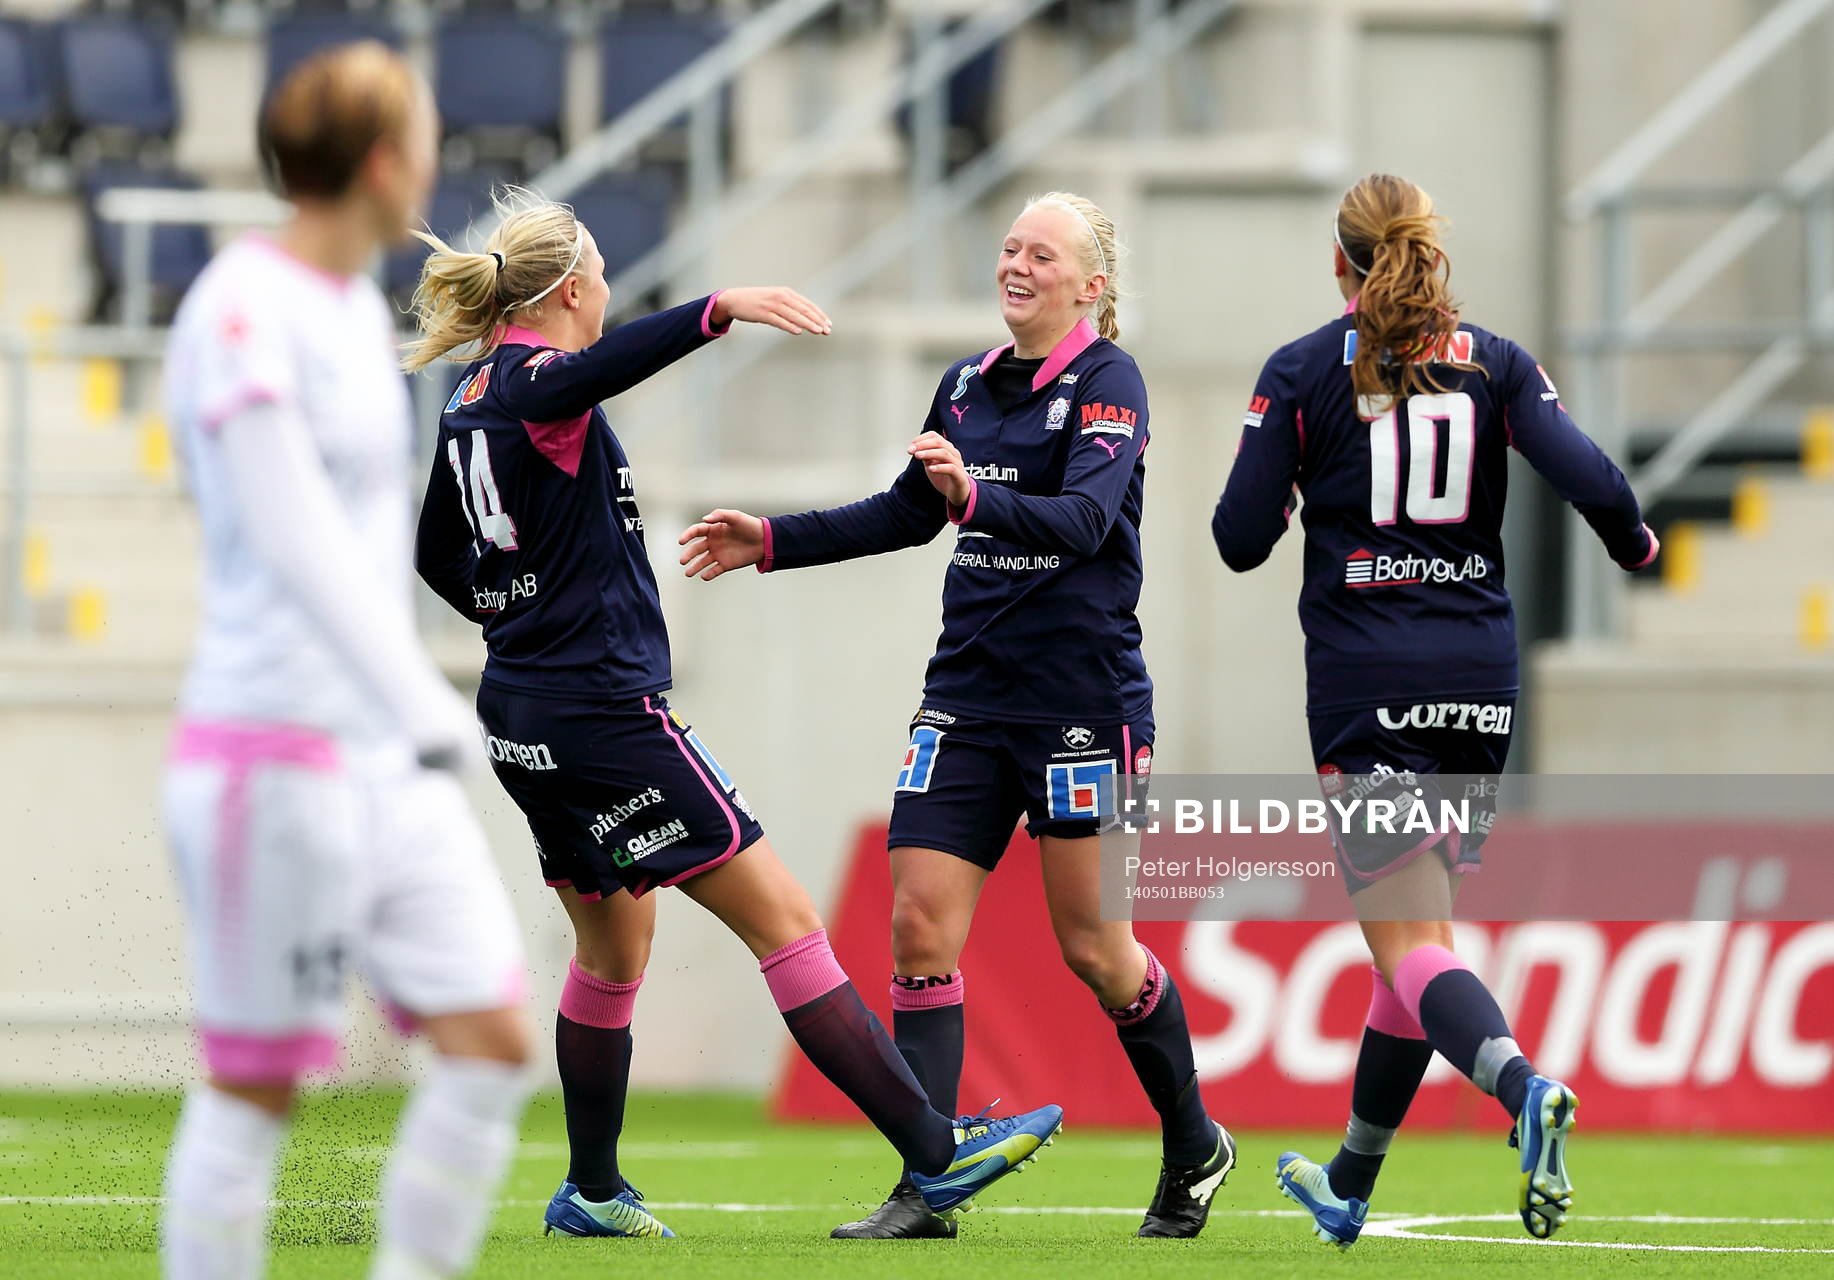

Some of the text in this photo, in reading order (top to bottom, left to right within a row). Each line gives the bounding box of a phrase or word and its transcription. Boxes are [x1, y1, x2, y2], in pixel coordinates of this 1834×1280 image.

[1080, 402, 1137, 427] MAXI
[1357, 391, 1476, 526] 10
[447, 429, 519, 558] 14
[953, 552, 1060, 570] TERIAL HANDLING
[1459, 554, 1487, 579] AB
[511, 573, 537, 601] AB
[1376, 702, 1512, 735] Corren
[480, 722, 558, 771] orren
[627, 818, 686, 854] QLEAN
[633, 830, 690, 861] SCANDINAVIA AB
